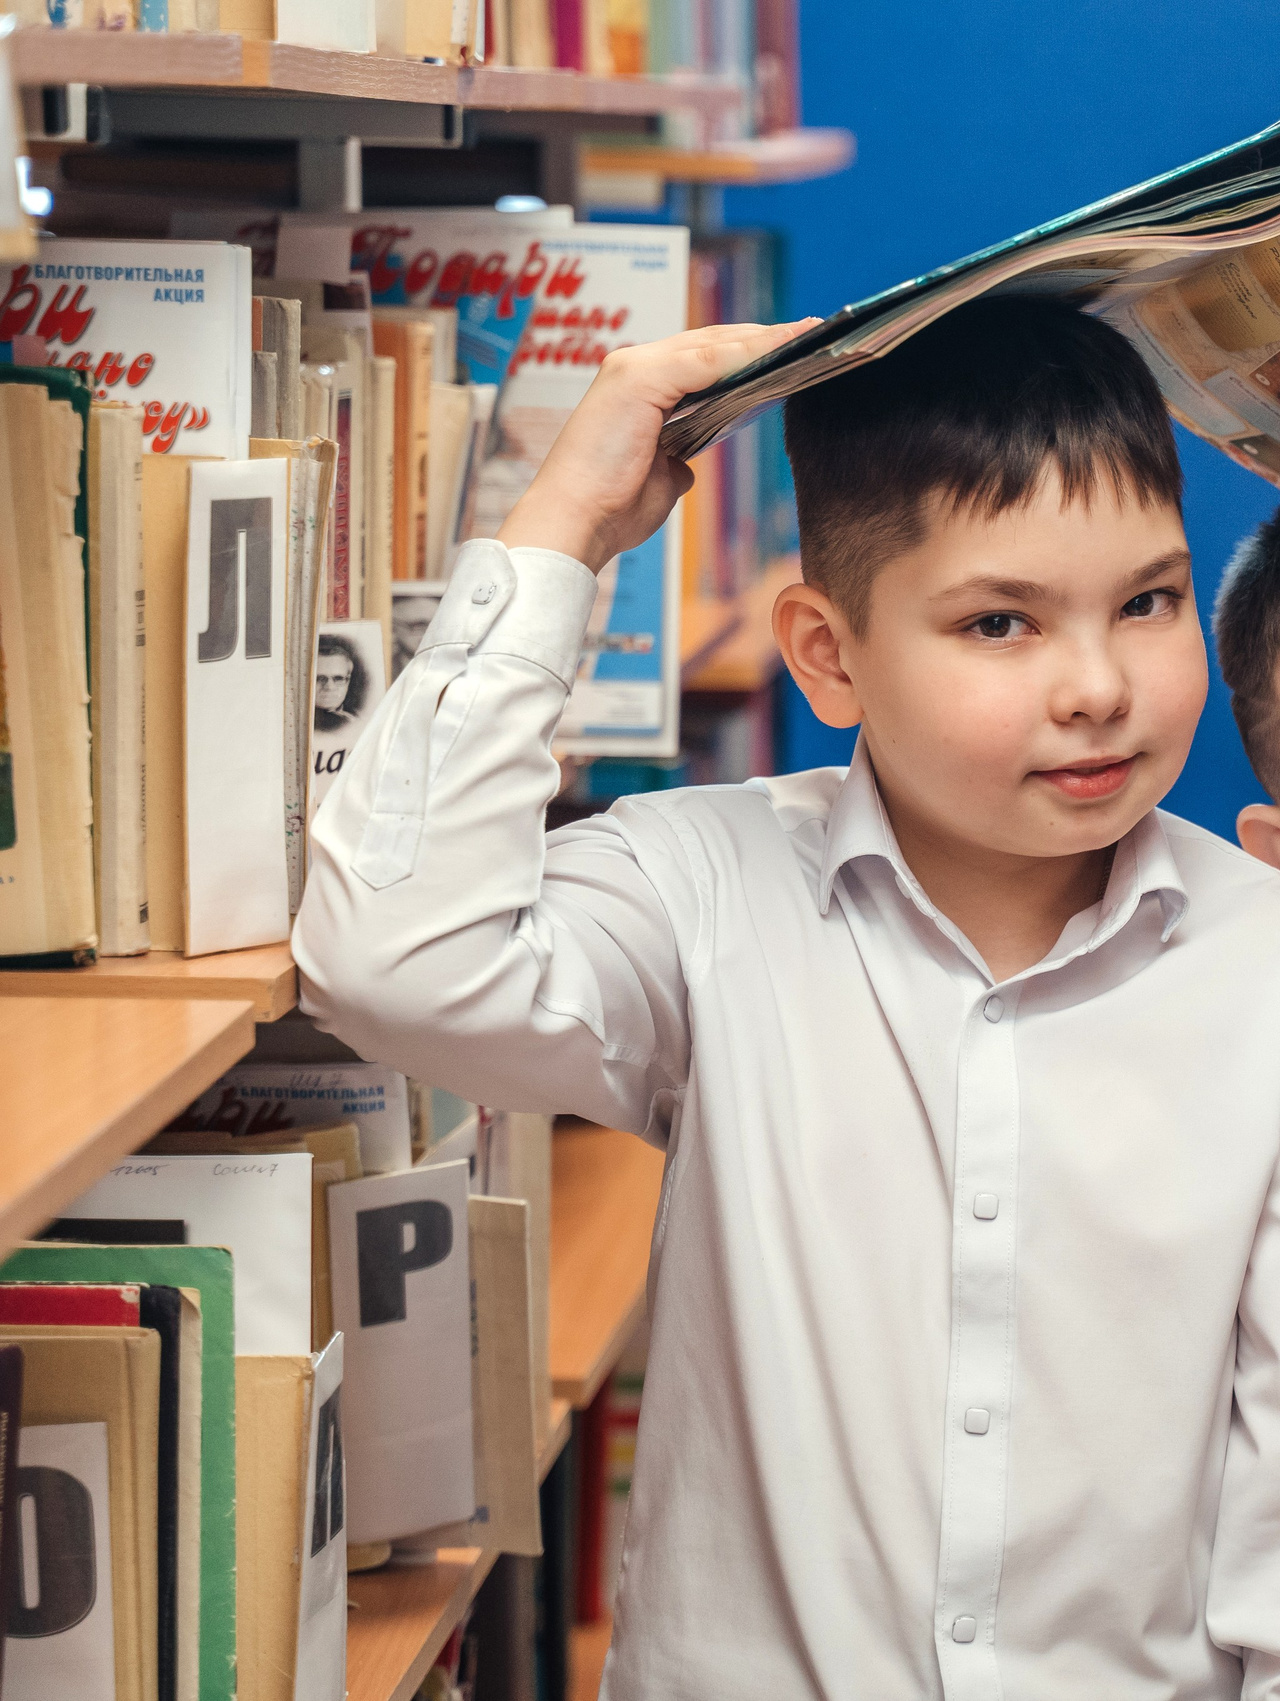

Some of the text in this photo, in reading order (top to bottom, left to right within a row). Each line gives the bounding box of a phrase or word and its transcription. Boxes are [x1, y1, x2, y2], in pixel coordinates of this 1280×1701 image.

[35, 264, 204, 283] БЛАГОТВОРИТЕЛЬНАЯ
[153, 287, 204, 304] АКЦИЯ
[198, 497, 272, 663] Л
[240, 1086, 385, 1100] БЛАГОТВОРИТЕЛЬНАЯ
[342, 1101, 386, 1114] АКЦИЯ
[356, 1199, 454, 1328] Р
